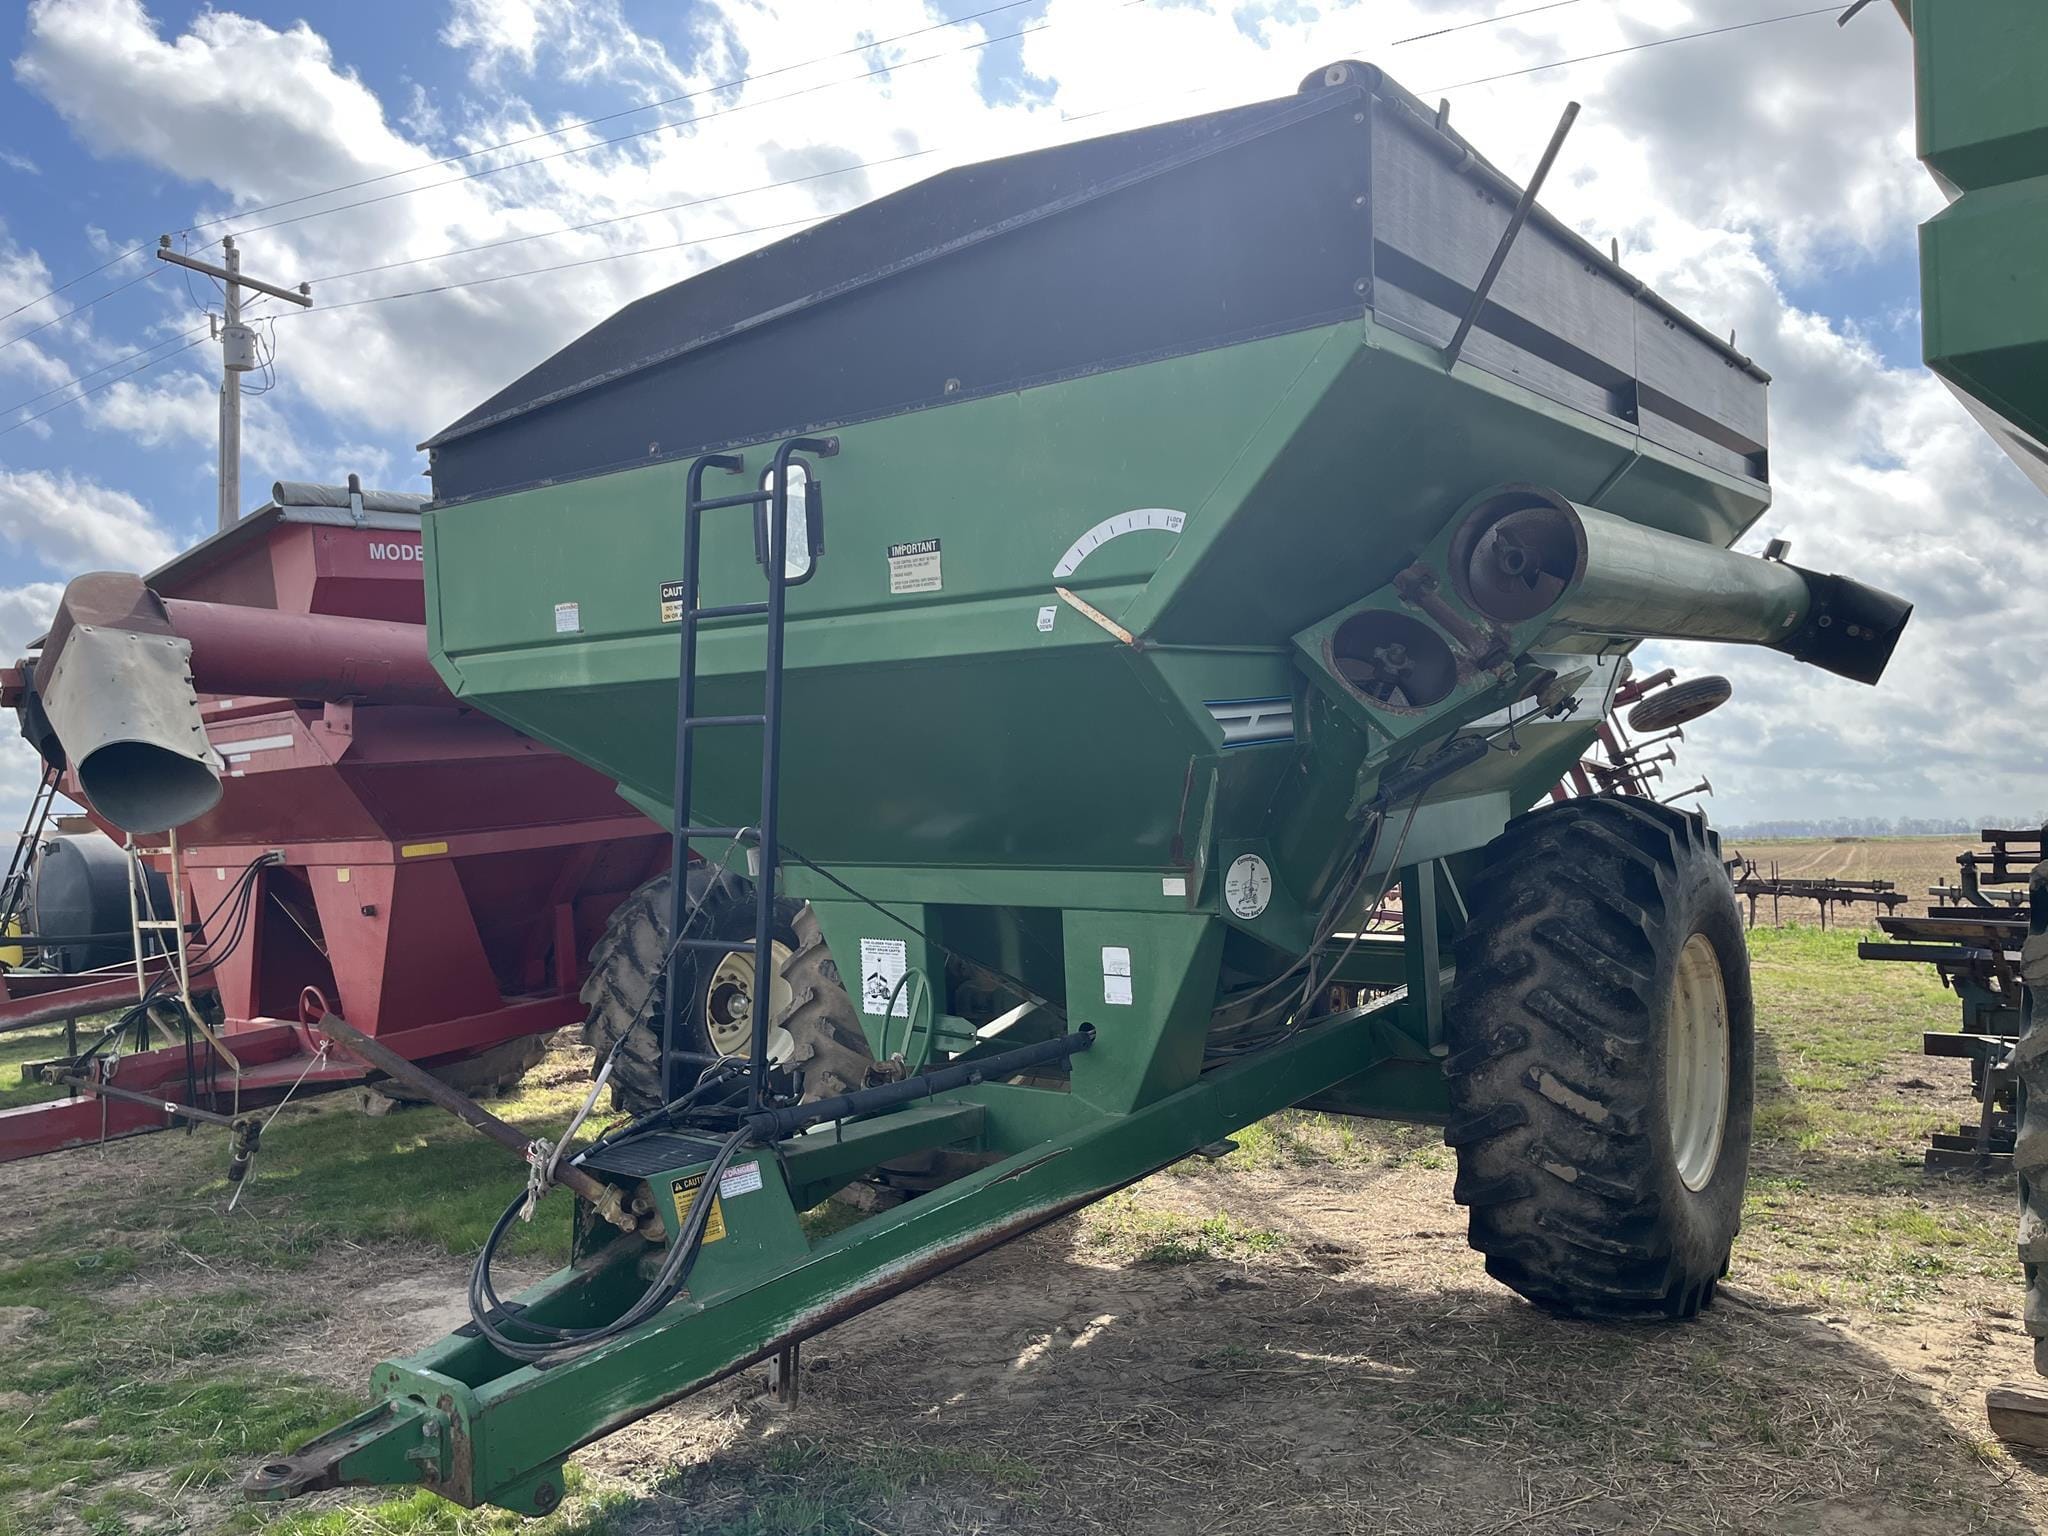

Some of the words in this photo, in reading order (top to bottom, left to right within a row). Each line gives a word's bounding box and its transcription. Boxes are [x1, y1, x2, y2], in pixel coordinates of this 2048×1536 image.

[369, 543, 423, 561] MODE
[891, 540, 937, 557] IMPORTANT
[663, 586, 683, 598] CAUT
[728, 1163, 757, 1177] DANGER
[684, 1175, 704, 1188] CAUTI
